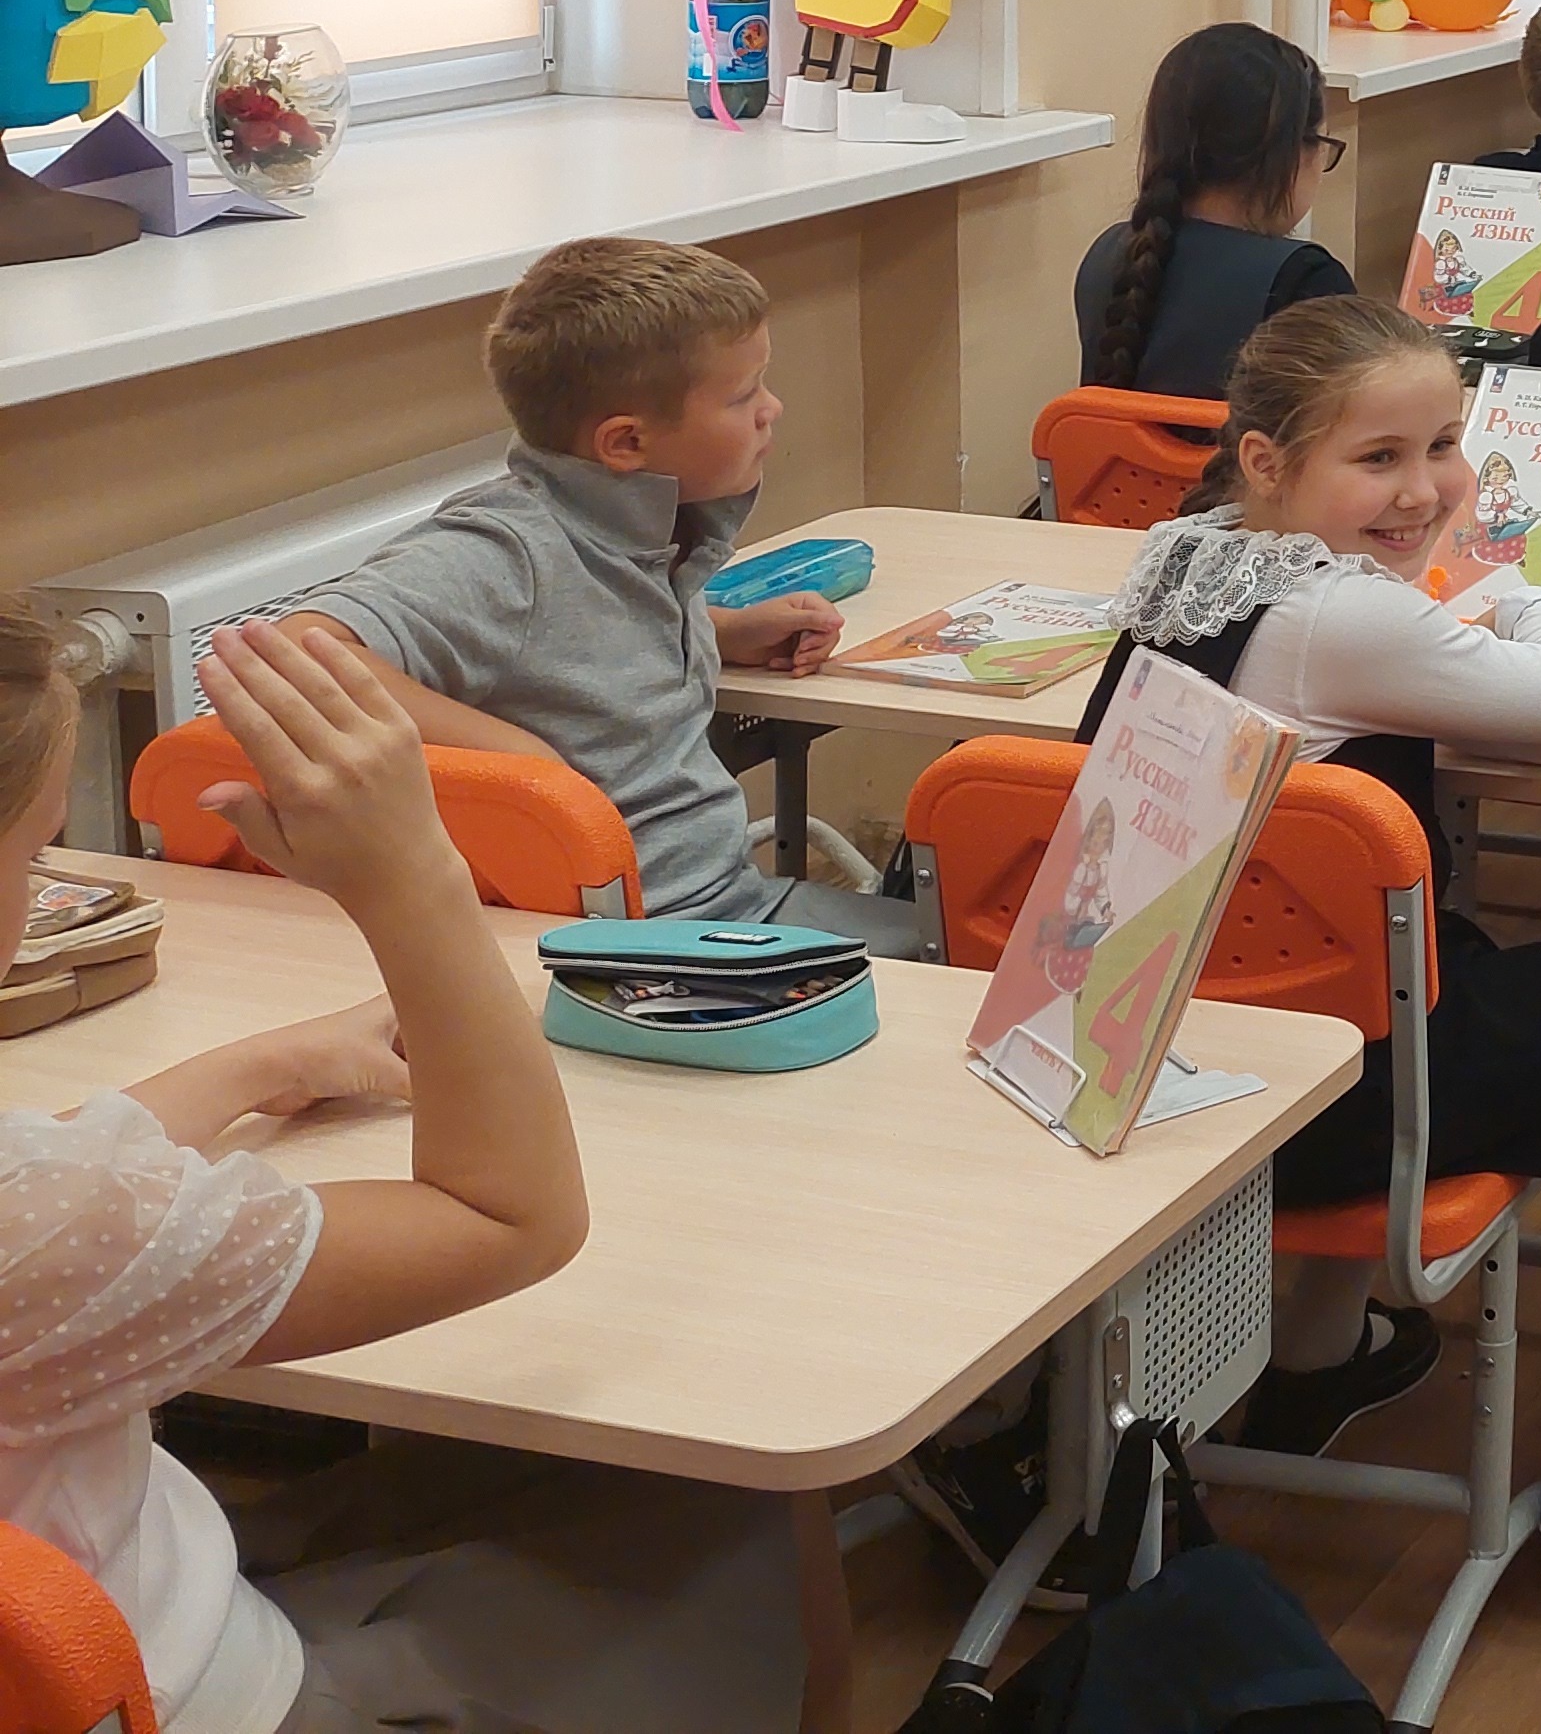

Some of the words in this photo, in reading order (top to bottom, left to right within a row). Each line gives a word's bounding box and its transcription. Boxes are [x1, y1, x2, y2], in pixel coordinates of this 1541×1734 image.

[1435, 195, 1516, 222] Русский
[1106, 724, 1191, 804] Русский
[1088, 931, 1181, 1099] 4
